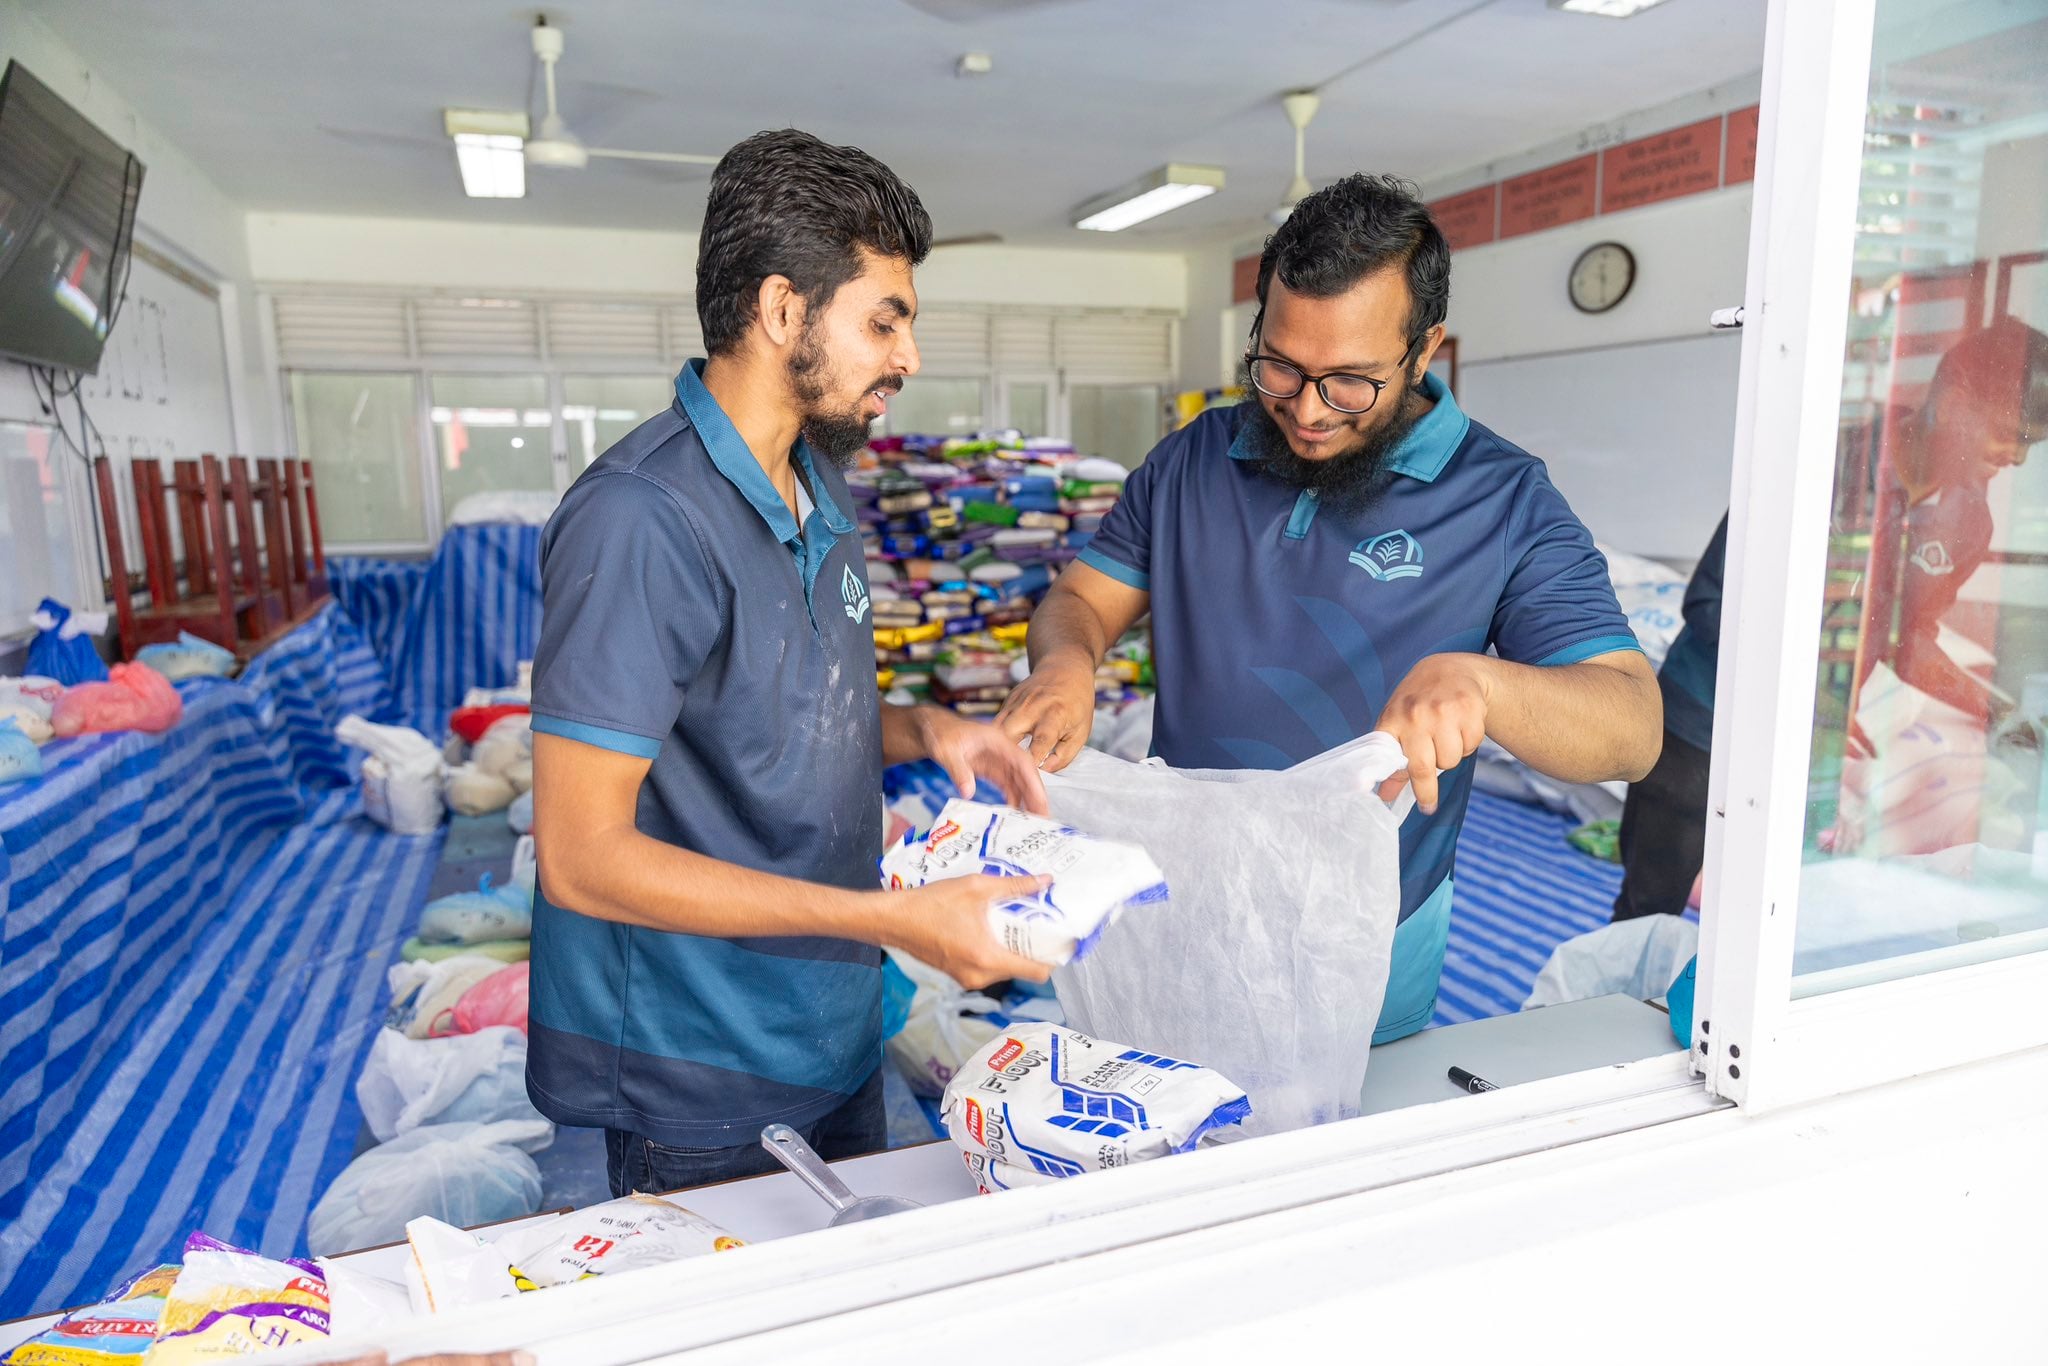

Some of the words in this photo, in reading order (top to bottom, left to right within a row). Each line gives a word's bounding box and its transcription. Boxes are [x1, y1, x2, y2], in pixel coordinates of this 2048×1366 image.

[1618, 149, 1701, 182] APPROPRIATE
[1006, 830, 1048, 856] PLAIN
[990, 1043, 1021, 1068] Prima
[979, 1050, 1049, 1094] Flour
[1081, 1060, 1116, 1084] PLAIN
[1090, 1062, 1128, 1088] FLOUR
[986, 1106, 1008, 1164] lour
[1098, 1144, 1108, 1170] LAIN
[560, 1256, 586, 1269] Fresh
